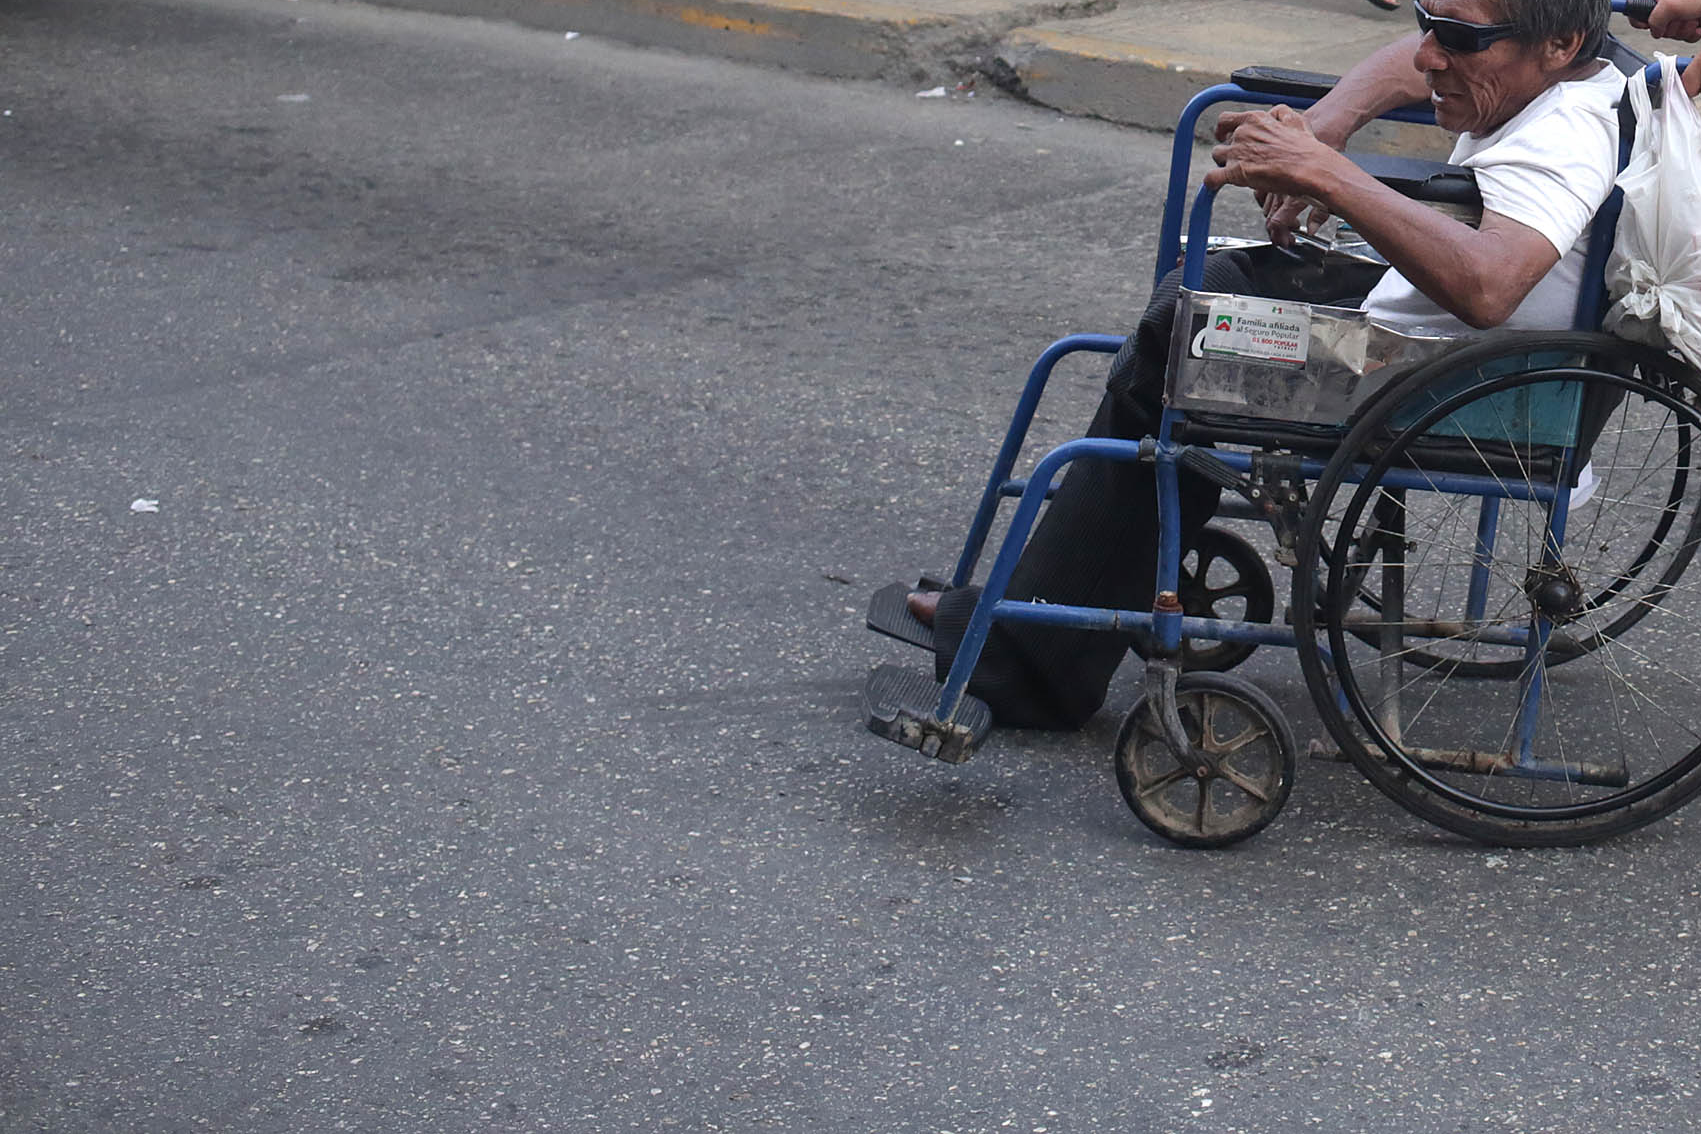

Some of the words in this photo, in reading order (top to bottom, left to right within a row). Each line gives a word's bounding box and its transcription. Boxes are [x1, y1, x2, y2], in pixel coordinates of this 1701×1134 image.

[1237, 317, 1267, 328] Familia
[1268, 320, 1300, 332] afiliada
[1244, 327, 1270, 337] Seguro
[1271, 330, 1299, 340] Popular
[1274, 339, 1298, 348] POPULAR
